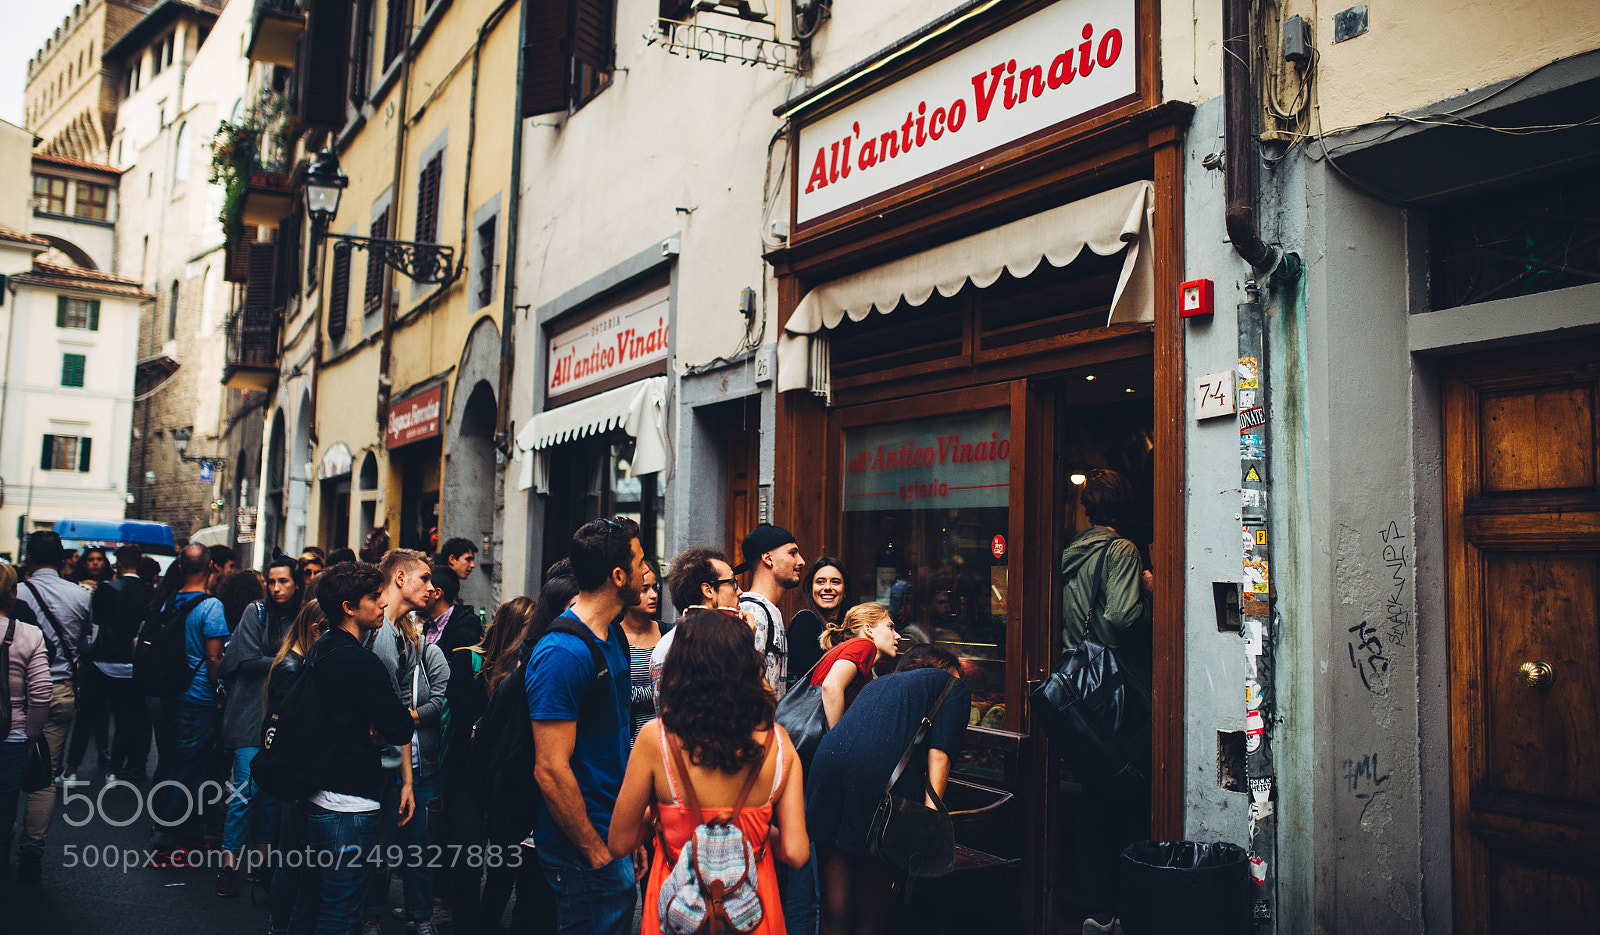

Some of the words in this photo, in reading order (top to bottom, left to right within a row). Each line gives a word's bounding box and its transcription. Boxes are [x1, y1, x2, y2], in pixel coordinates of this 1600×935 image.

[805, 98, 966, 194] All'antico
[971, 23, 1123, 122] Vinaio
[591, 315, 621, 337] OSTERIA
[551, 342, 615, 388] All'antico
[757, 358, 768, 377] 26
[1199, 381, 1226, 408] 74
[937, 432, 1011, 465] Vinaio
[899, 478, 948, 499] osteria
